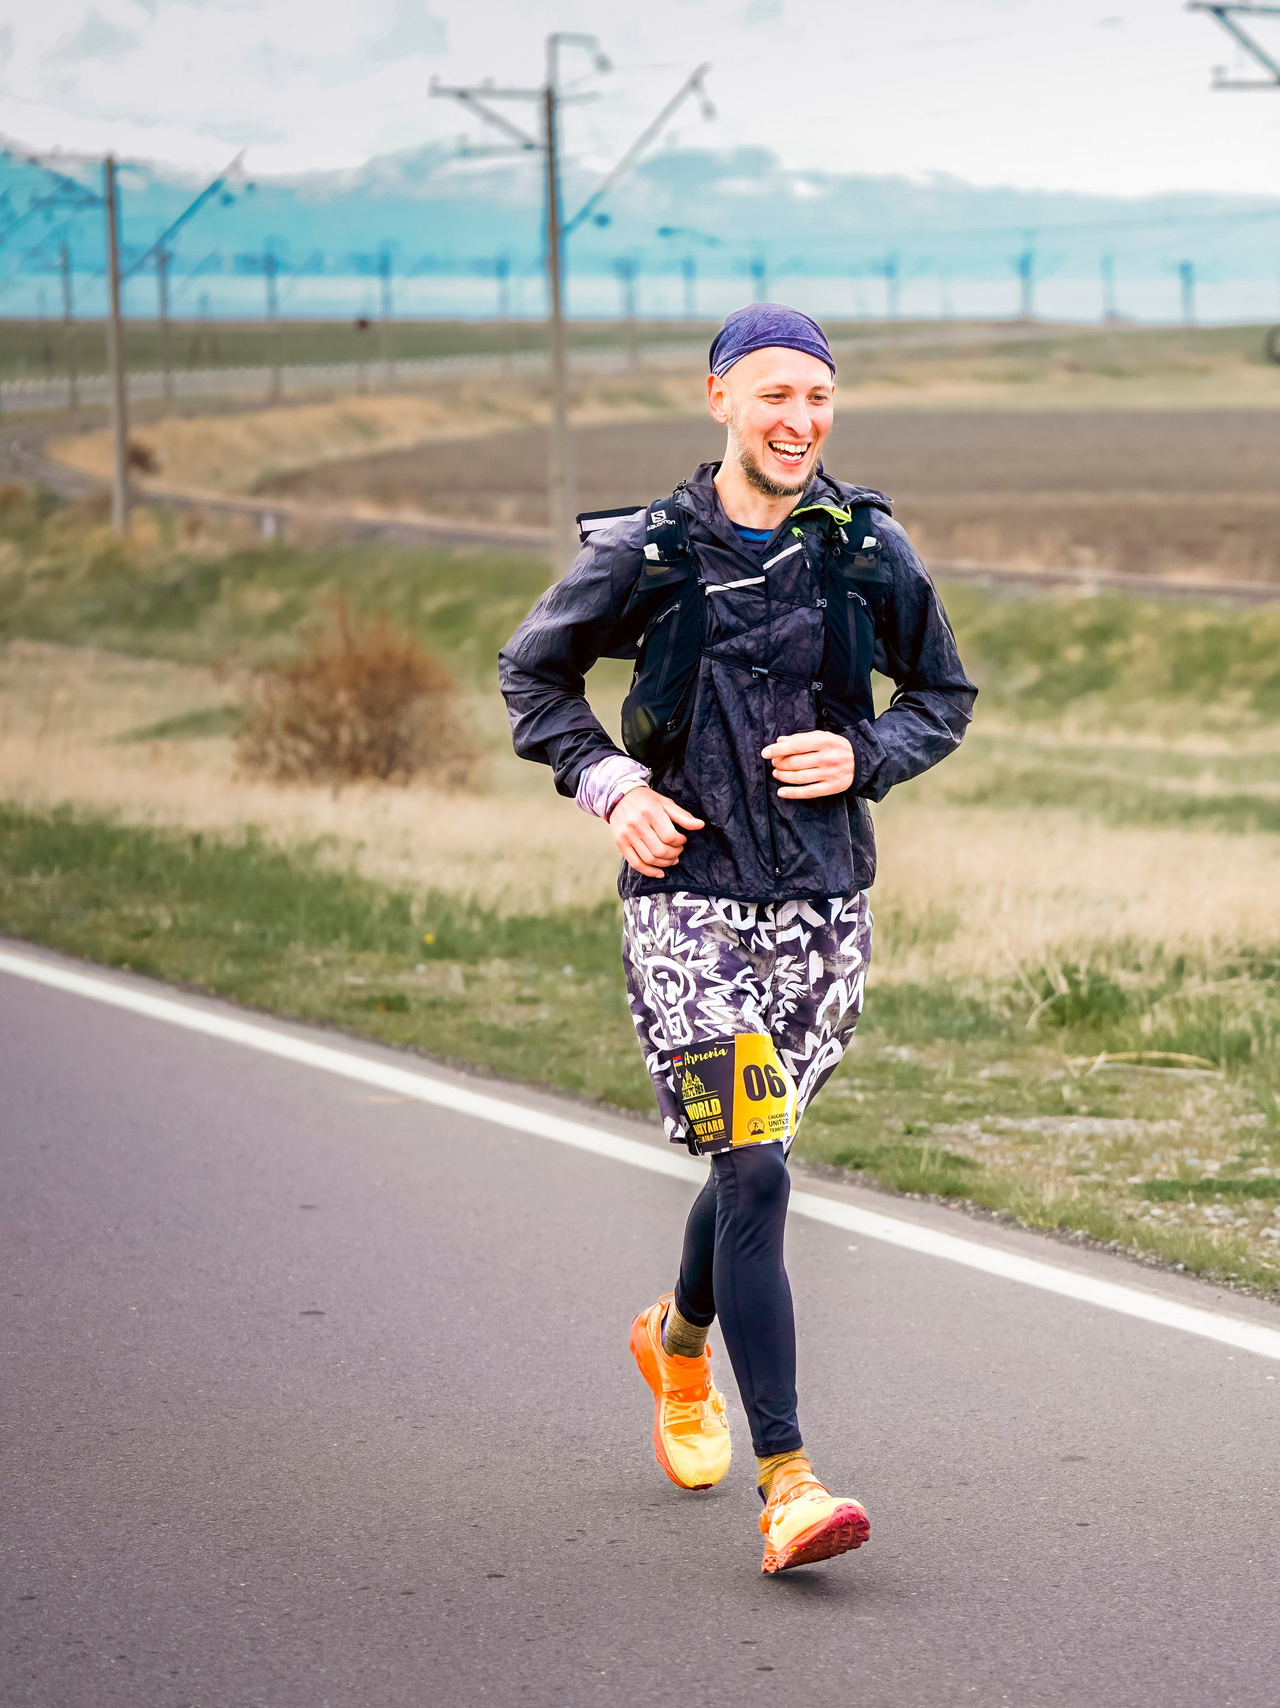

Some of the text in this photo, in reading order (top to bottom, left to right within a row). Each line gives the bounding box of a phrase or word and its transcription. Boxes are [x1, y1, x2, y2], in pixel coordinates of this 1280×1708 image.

[684, 1047, 728, 1066] Armenia
[743, 1064, 787, 1101] 06
[685, 1098, 722, 1121] WORLD
[692, 1118, 725, 1135] YARD
